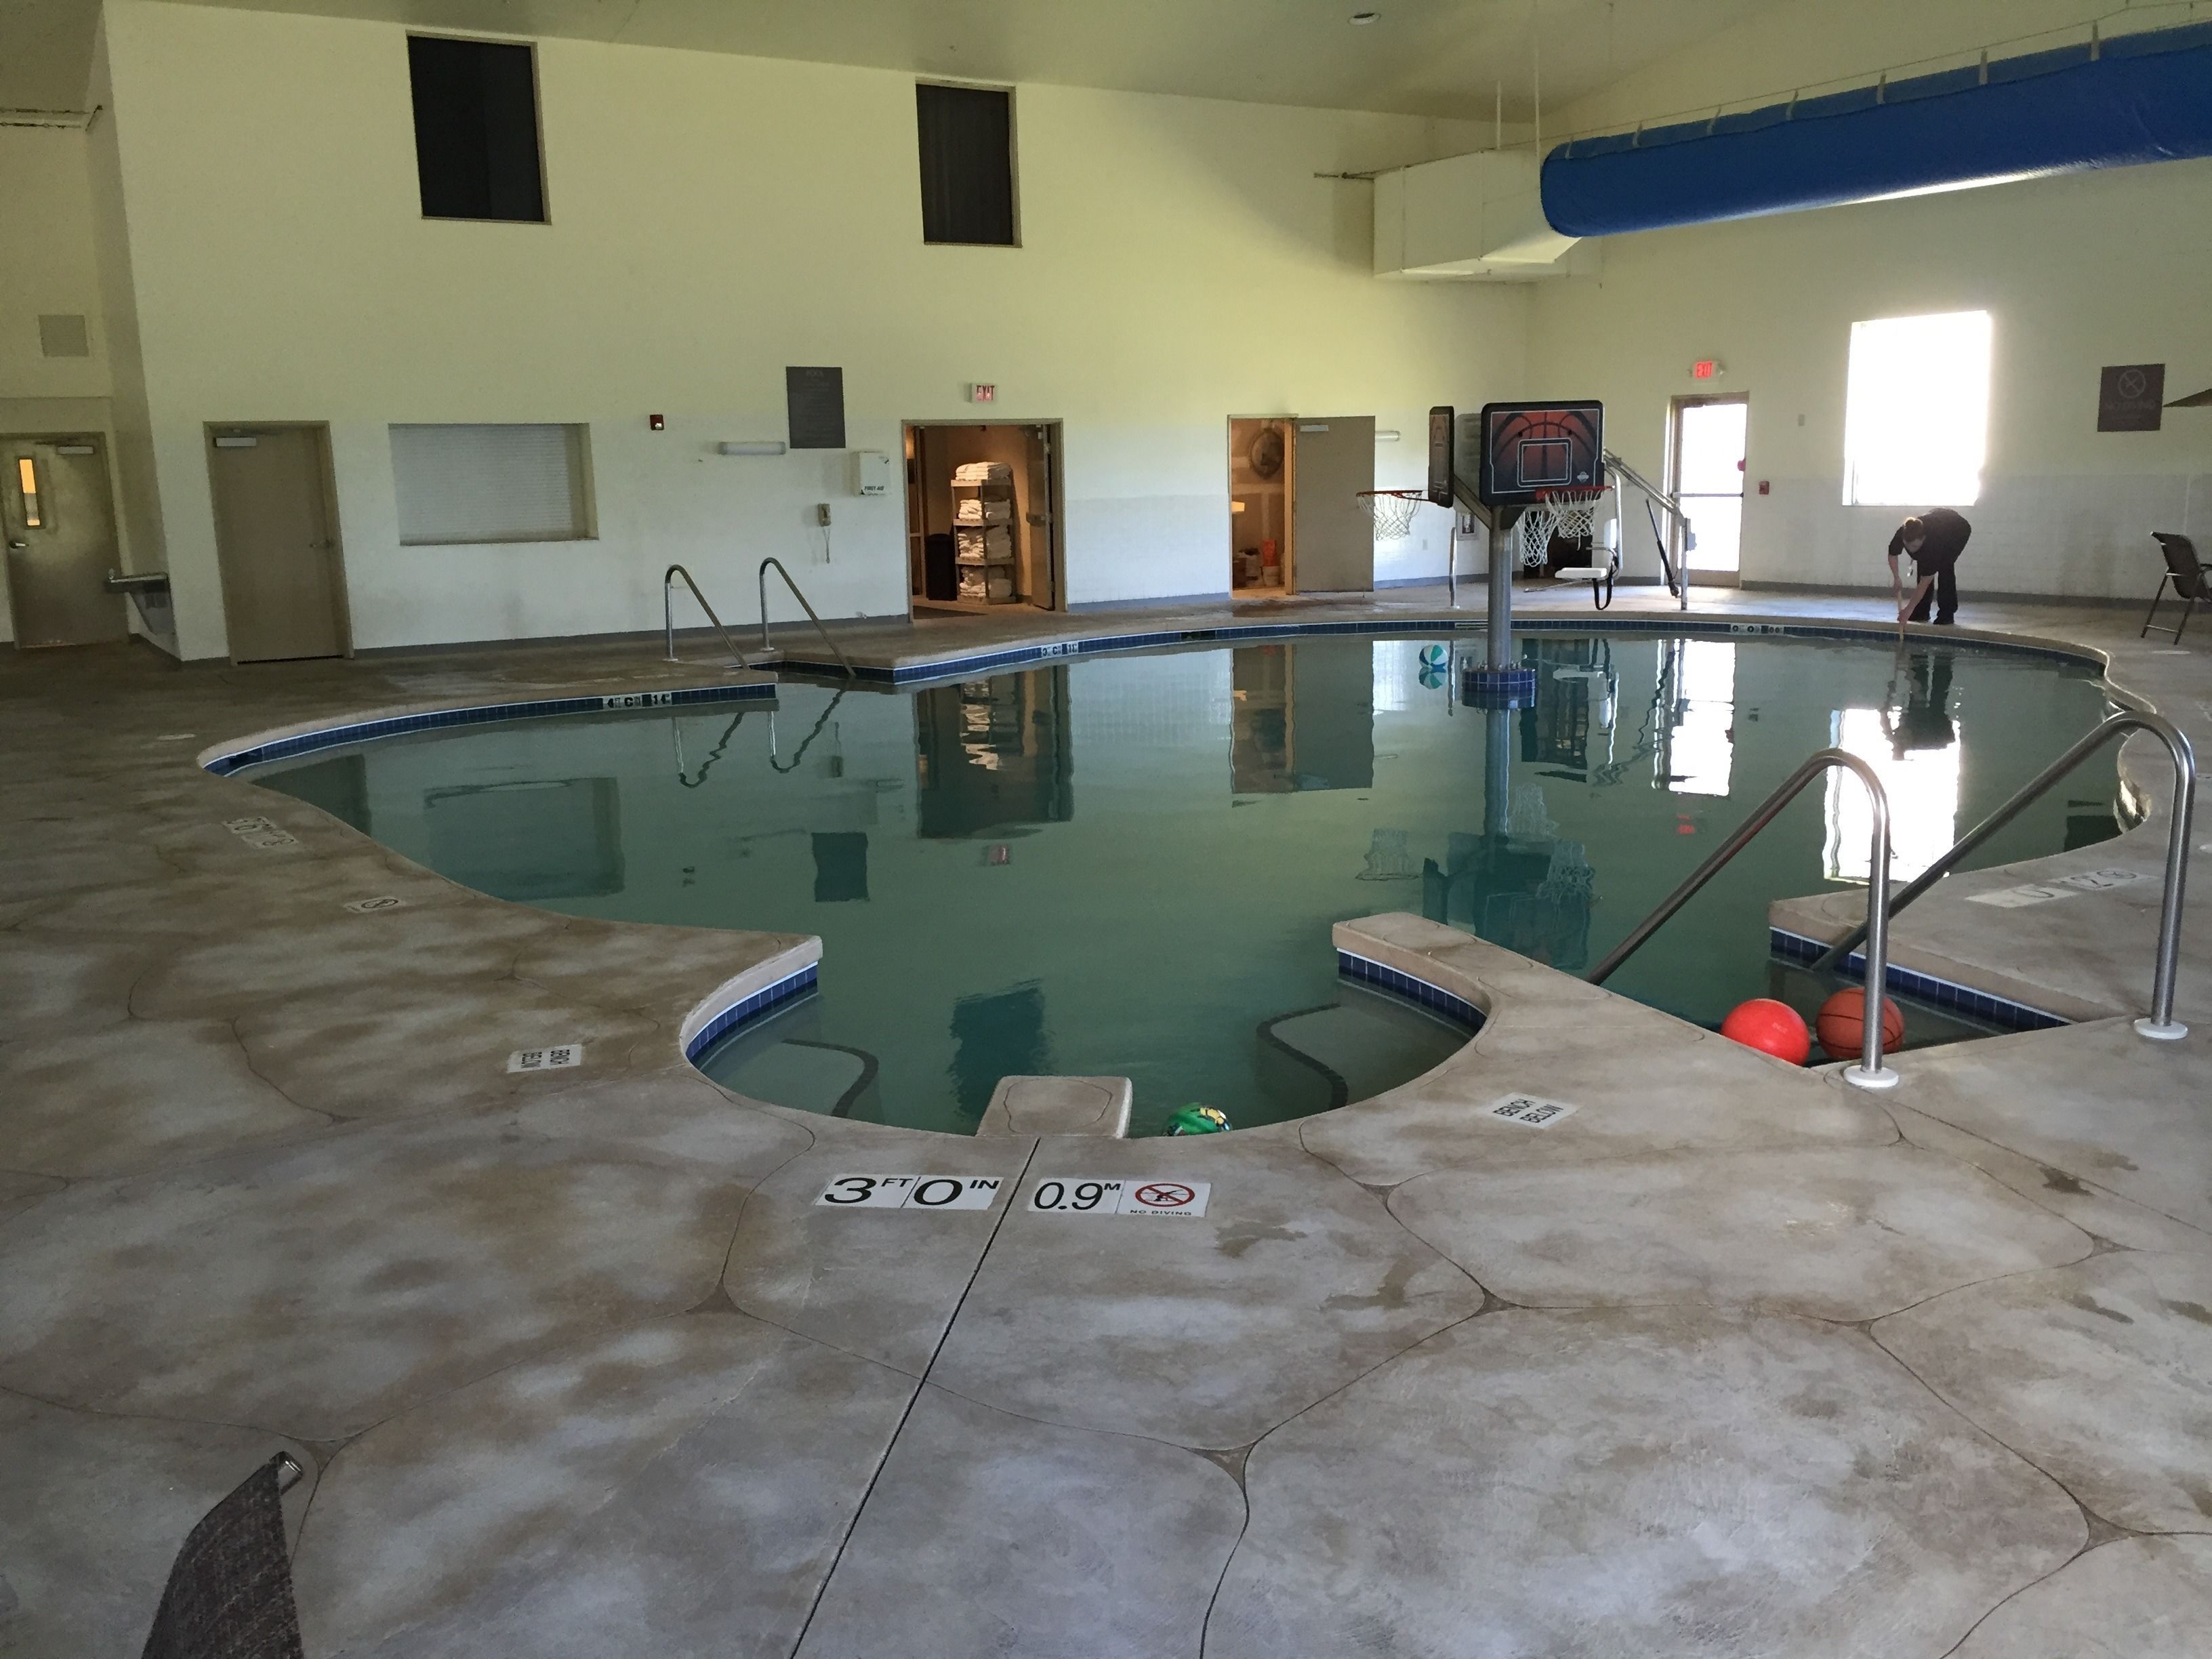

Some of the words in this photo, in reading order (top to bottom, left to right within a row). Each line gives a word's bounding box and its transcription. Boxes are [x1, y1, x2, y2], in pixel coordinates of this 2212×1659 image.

[976, 384, 995, 401] EXIT
[1492, 1098, 1536, 1117] BENCH
[1519, 1103, 1564, 1124] BELOW
